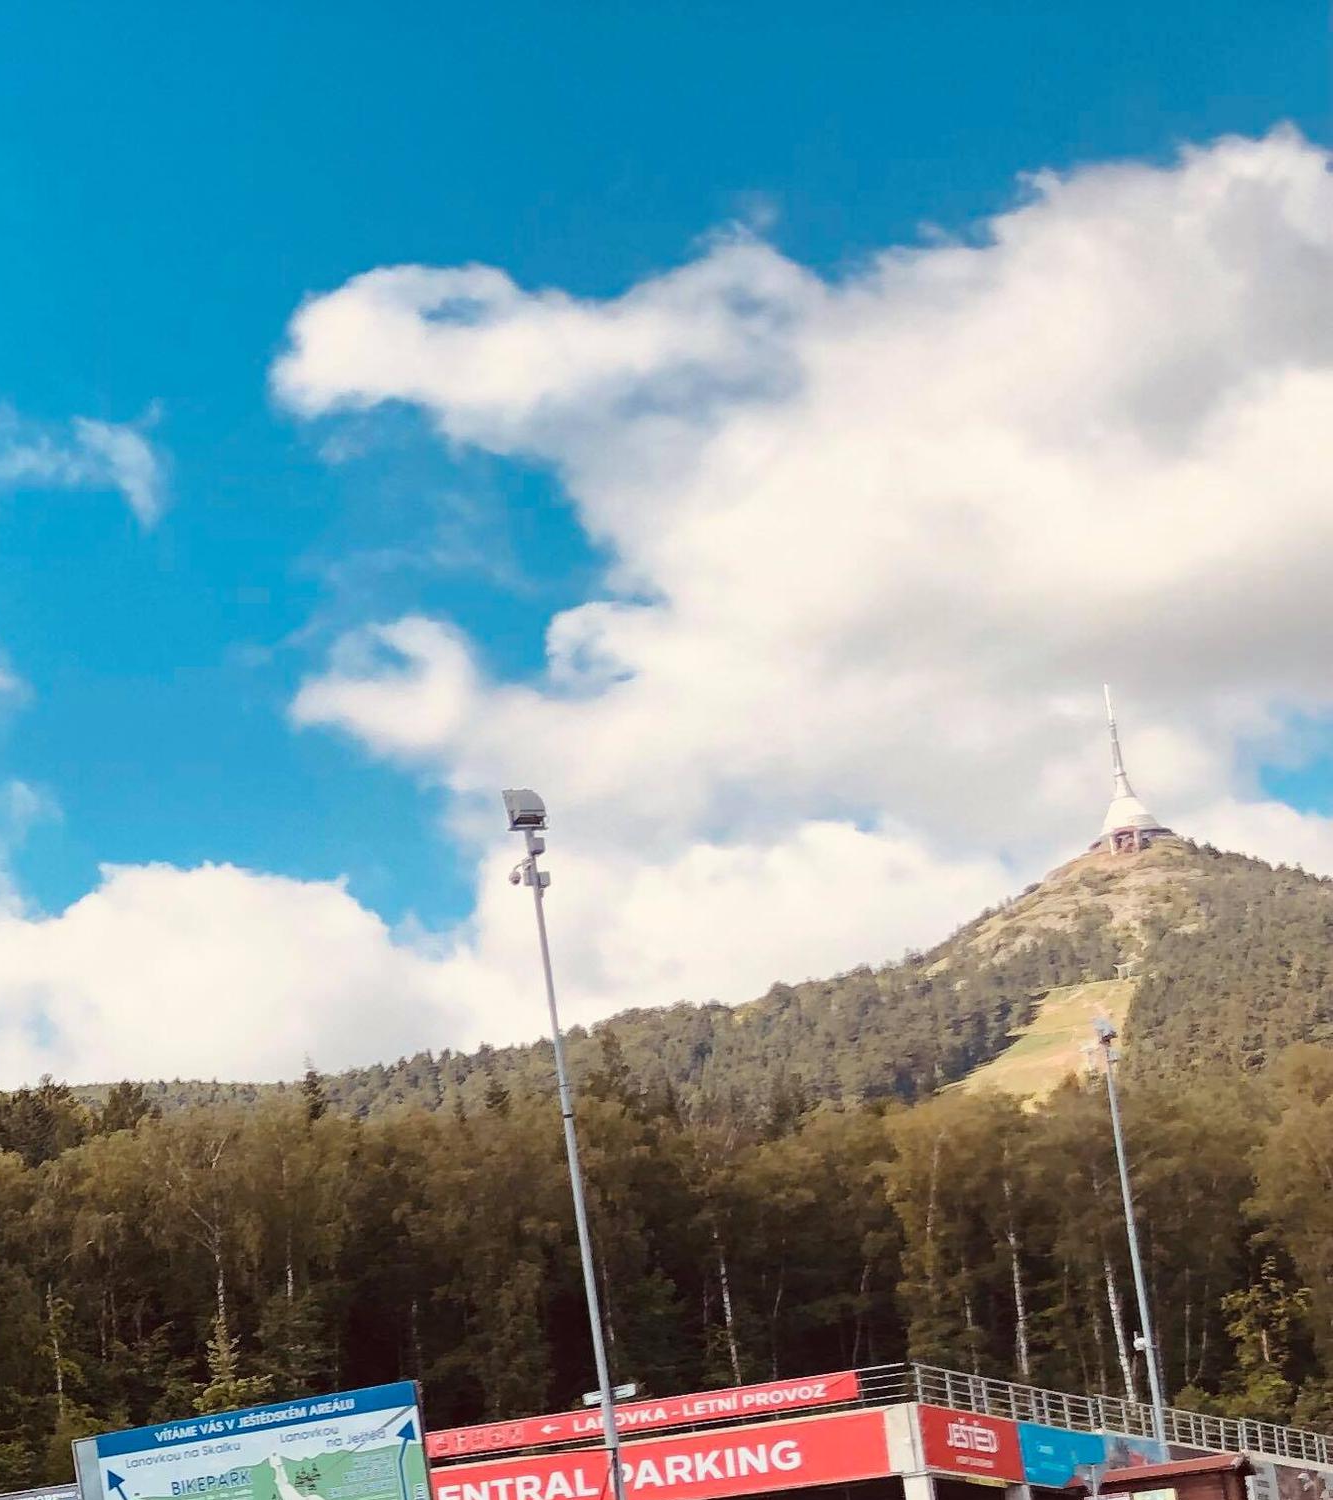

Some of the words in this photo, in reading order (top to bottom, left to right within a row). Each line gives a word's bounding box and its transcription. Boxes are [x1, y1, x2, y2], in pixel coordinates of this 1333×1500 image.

[683, 1392, 738, 1418] LETNÍ
[742, 1383, 827, 1408] PROVOZ
[200, 1421, 224, 1437] VÁS
[171, 1470, 251, 1496] BIKEPARK
